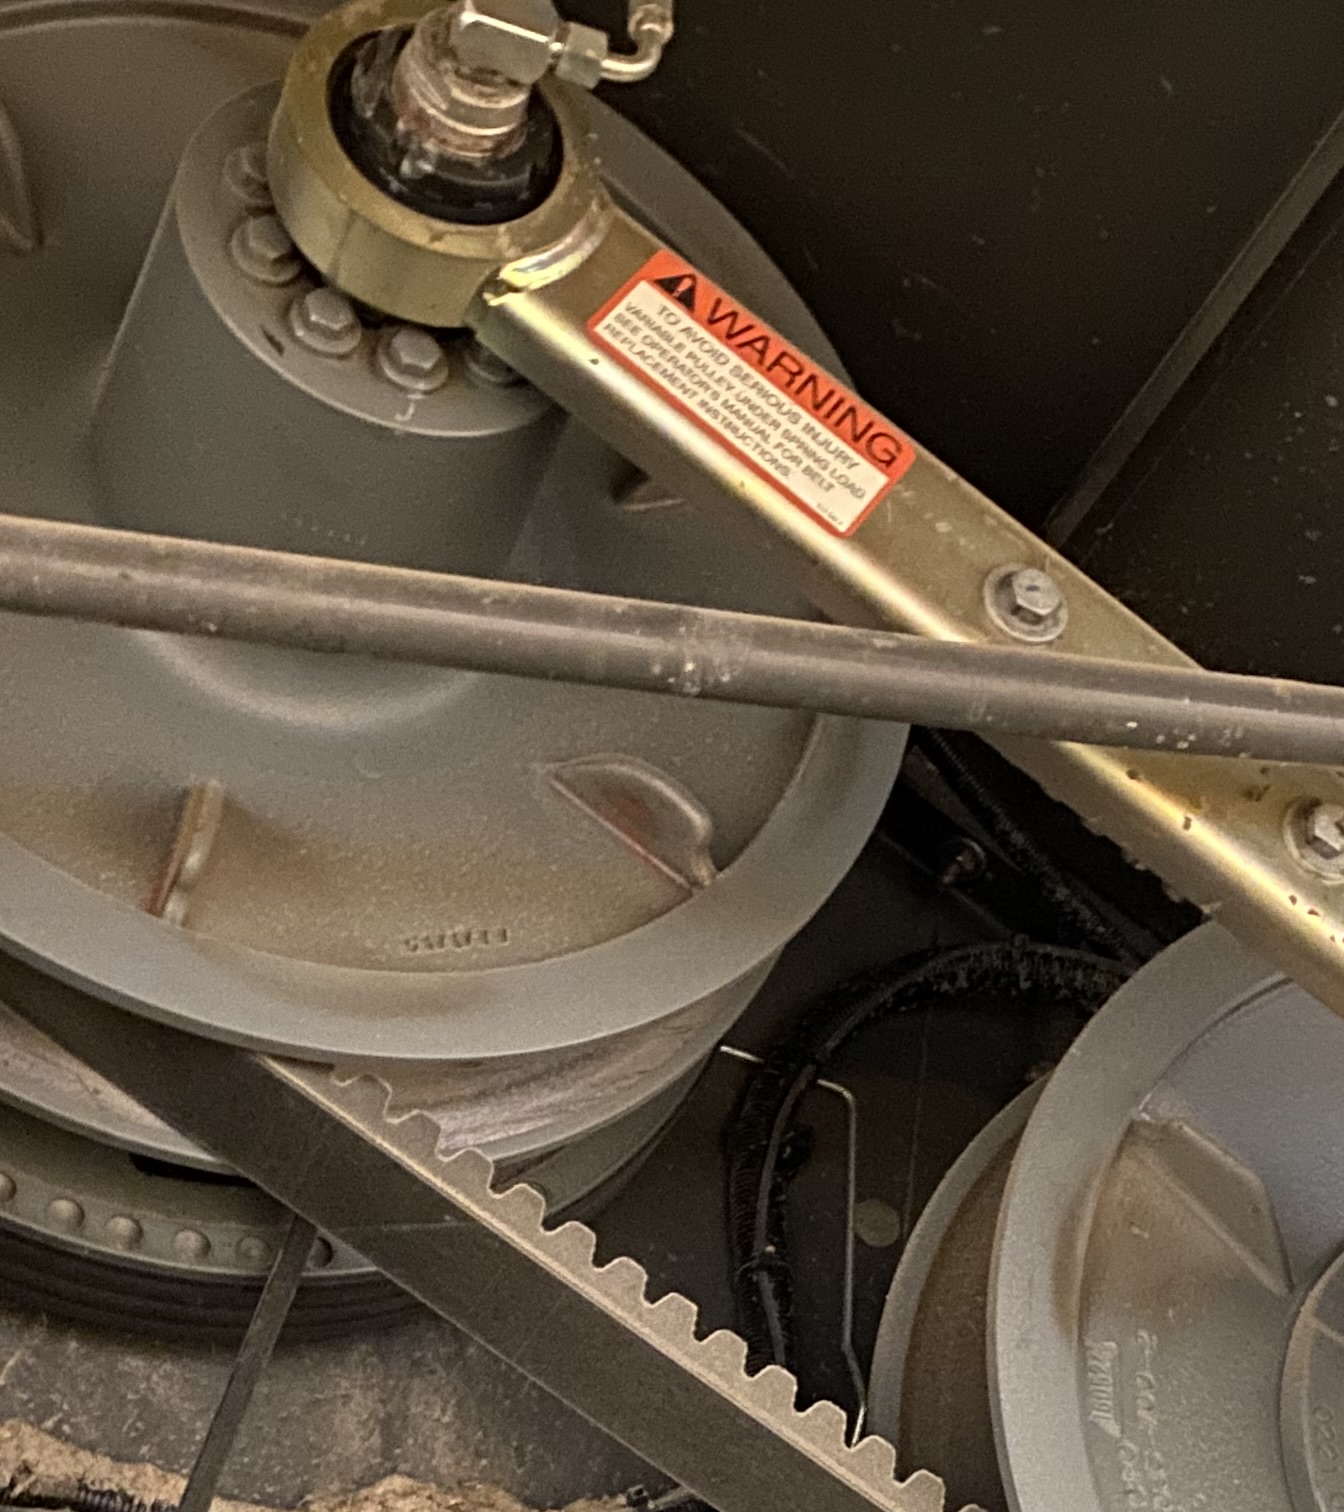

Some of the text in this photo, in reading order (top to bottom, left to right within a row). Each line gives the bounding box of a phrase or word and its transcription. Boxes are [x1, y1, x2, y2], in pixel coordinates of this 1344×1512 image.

[603, 322, 698, 402] REPLACEMENT
[613, 311, 836, 495] SEE OPERATOR'S MANUAL FOR BELT
[624, 301, 686, 354] VARIABLE
[684, 349, 736, 395] PULLEY
[734, 390, 783, 433] UNDER
[780, 427, 831, 472] SPRING
[655, 304, 860, 473] TO AVOID SERIOUS INJURY
[701, 295, 906, 470] WARNING
